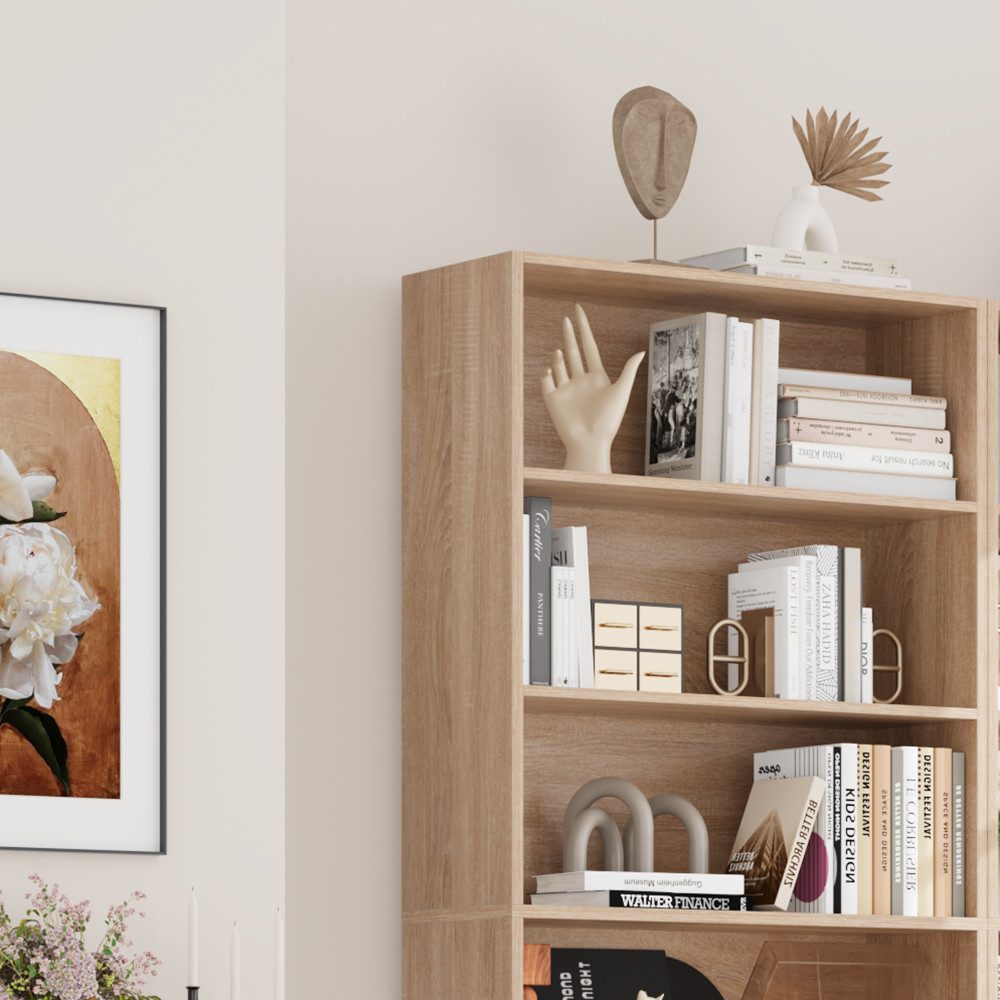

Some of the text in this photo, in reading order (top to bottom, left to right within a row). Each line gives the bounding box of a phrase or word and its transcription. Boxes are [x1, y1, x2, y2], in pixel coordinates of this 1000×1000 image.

[935, 436, 944, 445] 2
[871, 453, 950, 470] No search result for
[534, 509, 550, 562] Cartier
[822, 583, 831, 664] ZAHA HADID
[624, 879, 703, 889] Guggenheim Museum
[620, 893, 730, 911] WALTER FINANCE
[578, 961, 595, 1000] NIGHT
